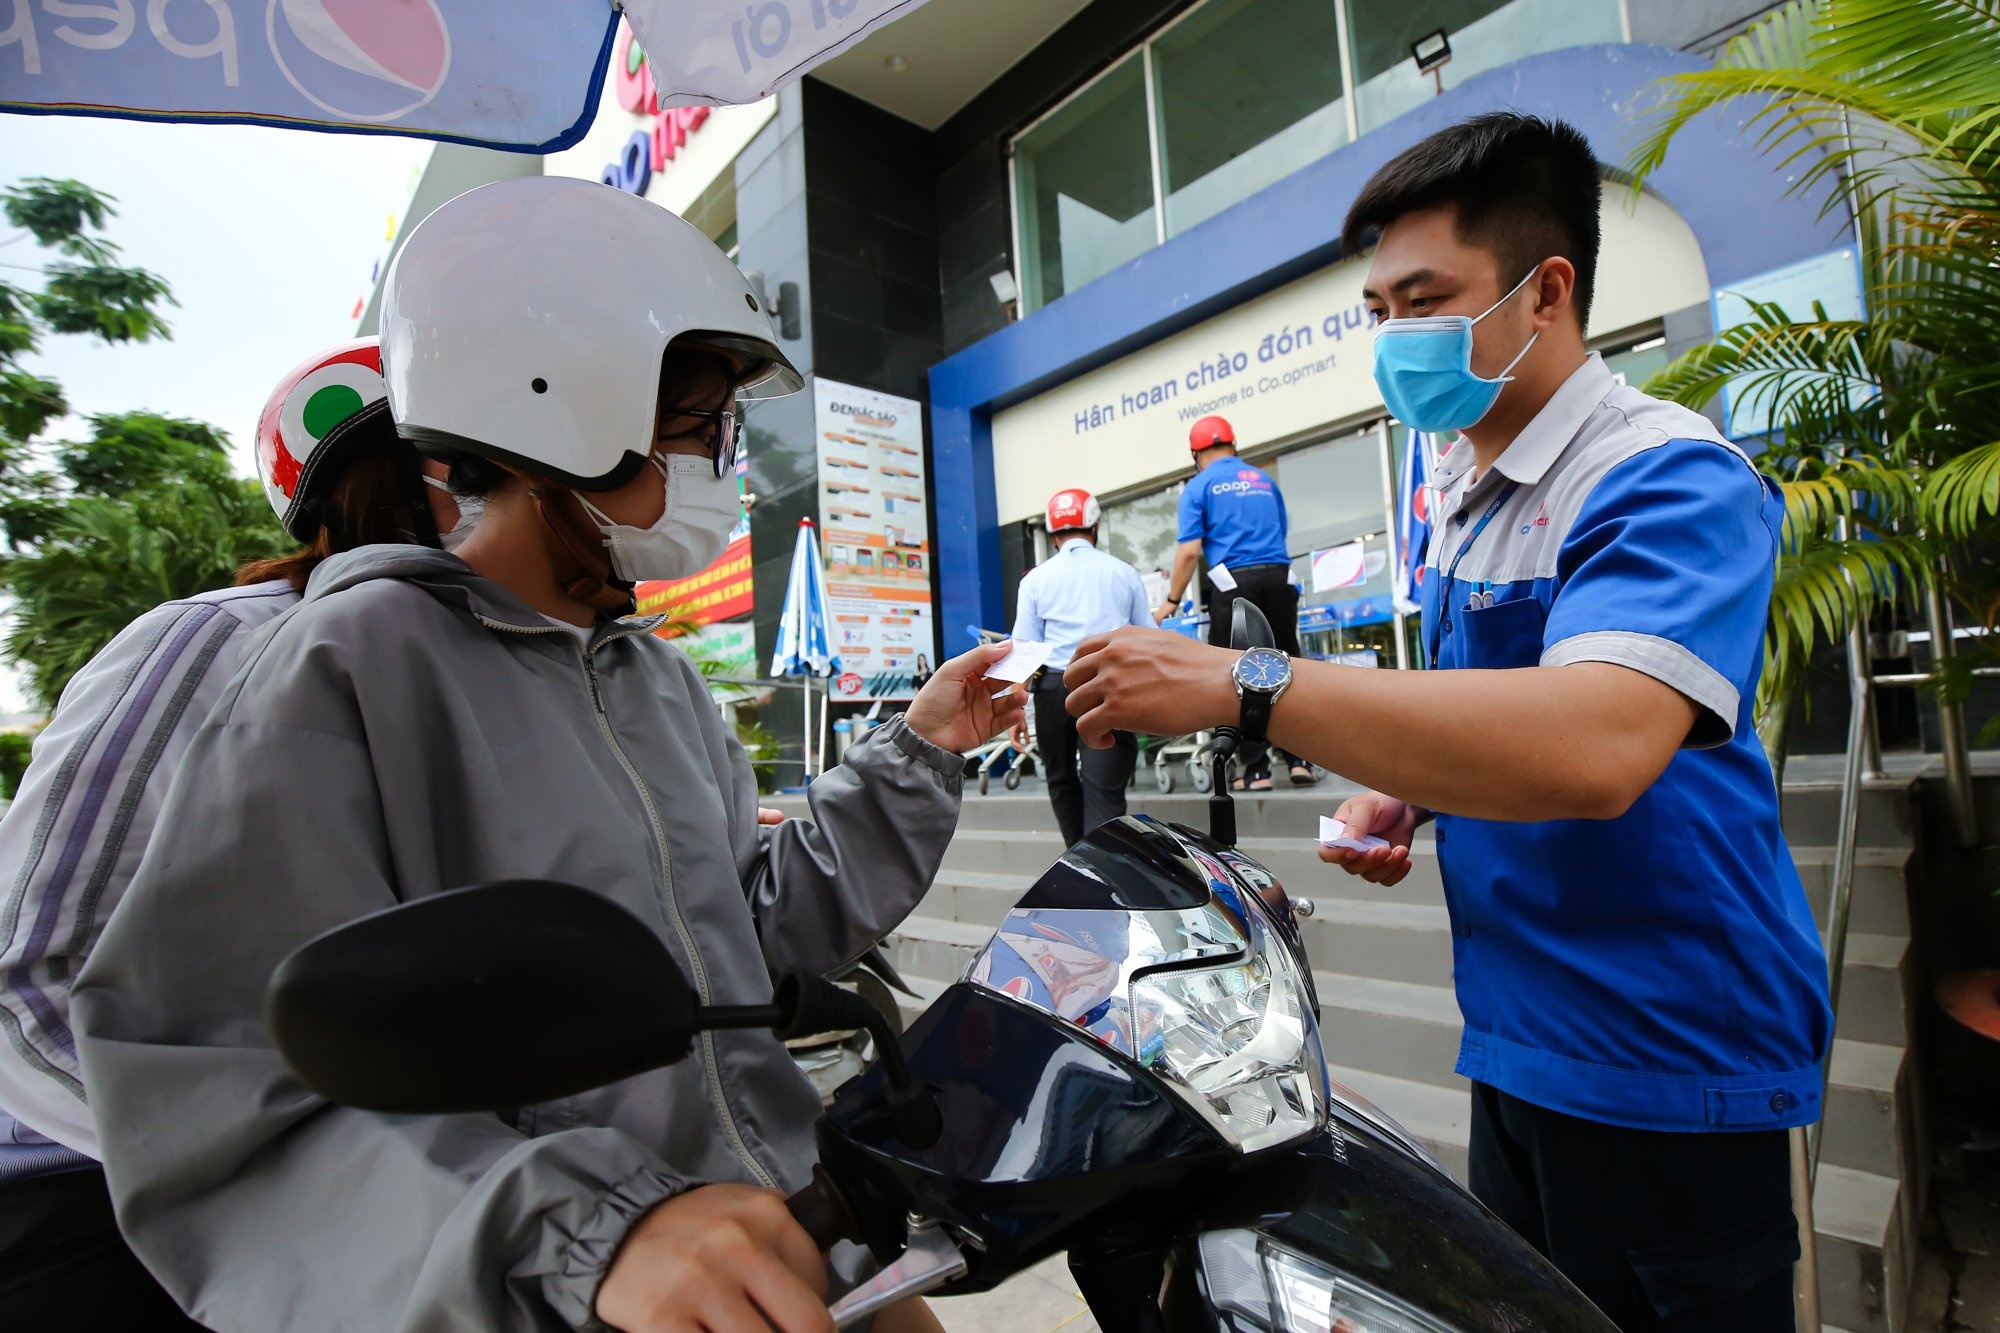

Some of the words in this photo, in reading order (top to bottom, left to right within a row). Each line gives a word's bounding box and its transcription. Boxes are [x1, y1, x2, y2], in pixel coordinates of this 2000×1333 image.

[1074, 404, 1115, 434] Hân
[1121, 379, 1178, 417] hoan
[1185, 352, 1248, 391] chào
[1257, 325, 1313, 363] đón
[1178, 390, 1238, 422] Welcome
[1240, 386, 1254, 399] to
[1258, 353, 1337, 393] Co.opmart
